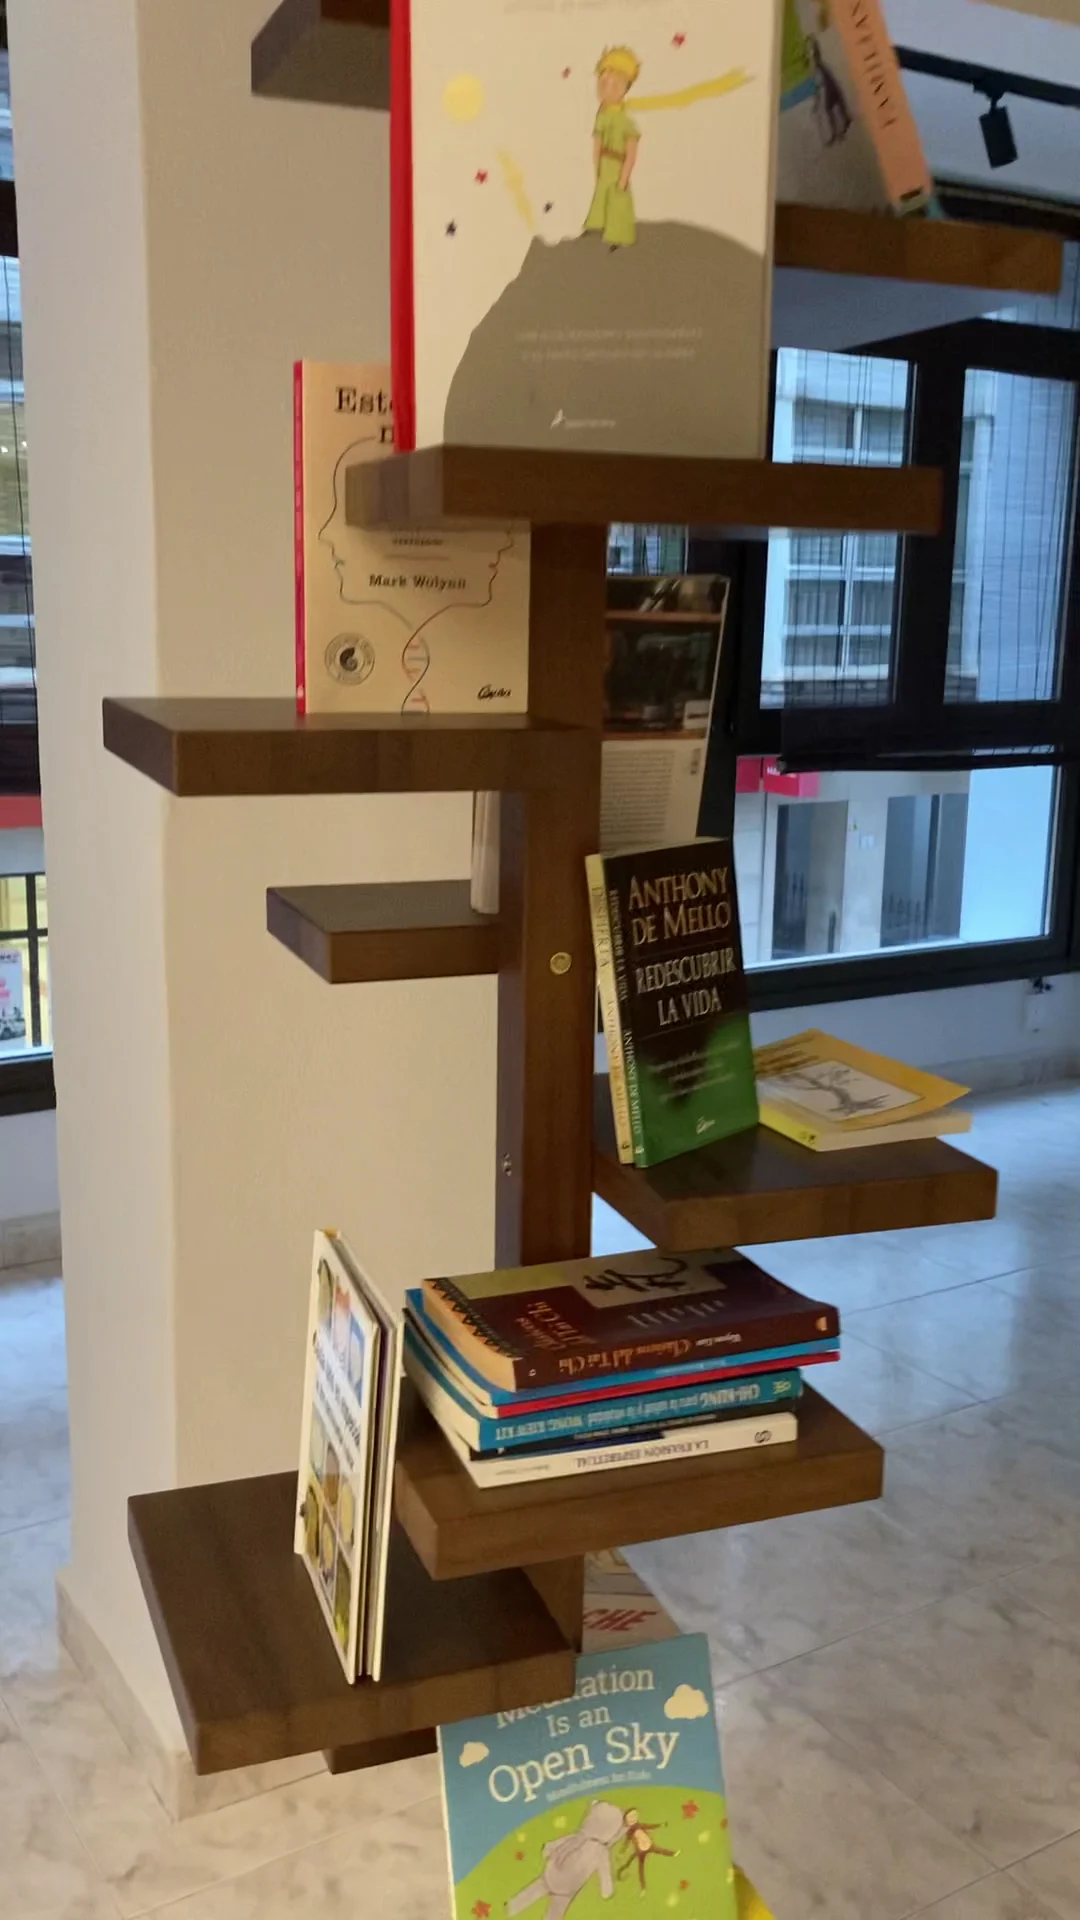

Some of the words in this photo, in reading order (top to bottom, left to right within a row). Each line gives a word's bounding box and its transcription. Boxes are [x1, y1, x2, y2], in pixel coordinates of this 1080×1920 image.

[334, 386, 393, 415] Est
[369, 574, 407, 588] Mark
[628, 867, 729, 912] ANTHONY
[631, 915, 659, 947] DE
[635, 947, 737, 994] REDESCUBRIR
[657, 999, 680, 1027] LA
[681, 986, 723, 1019] VIDA
[545, 1714, 571, 1738] Is
[577, 1705, 613, 1729] an
[487, 1741, 595, 1804] Open
[604, 1721, 681, 1770] Sky
